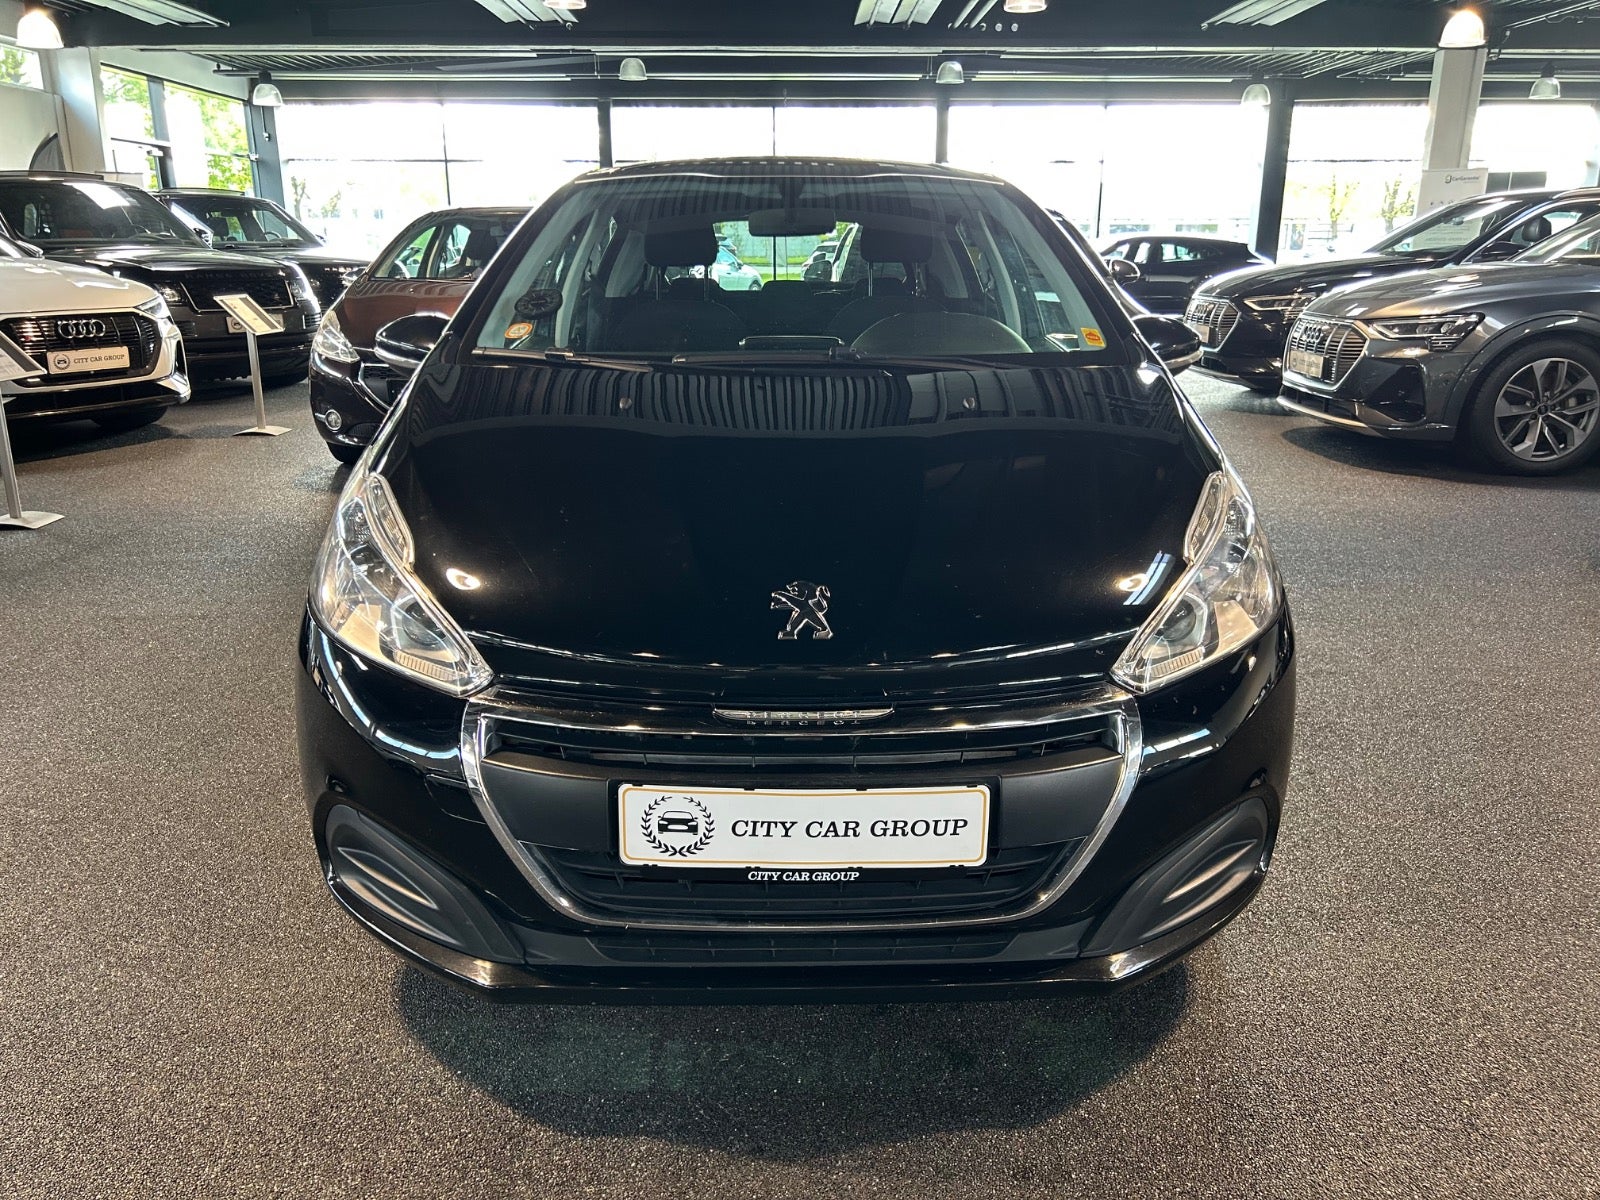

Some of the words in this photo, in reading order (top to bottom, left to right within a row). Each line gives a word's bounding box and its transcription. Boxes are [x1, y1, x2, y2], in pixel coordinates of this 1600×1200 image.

[104, 354, 125, 362] GROUP
[731, 820, 799, 838] CITY
[805, 820, 861, 838] CAR
[870, 818, 968, 838] GROUP
[748, 871, 781, 882] CITY
[782, 871, 811, 882] CAR
[812, 871, 860, 882] GROUP
